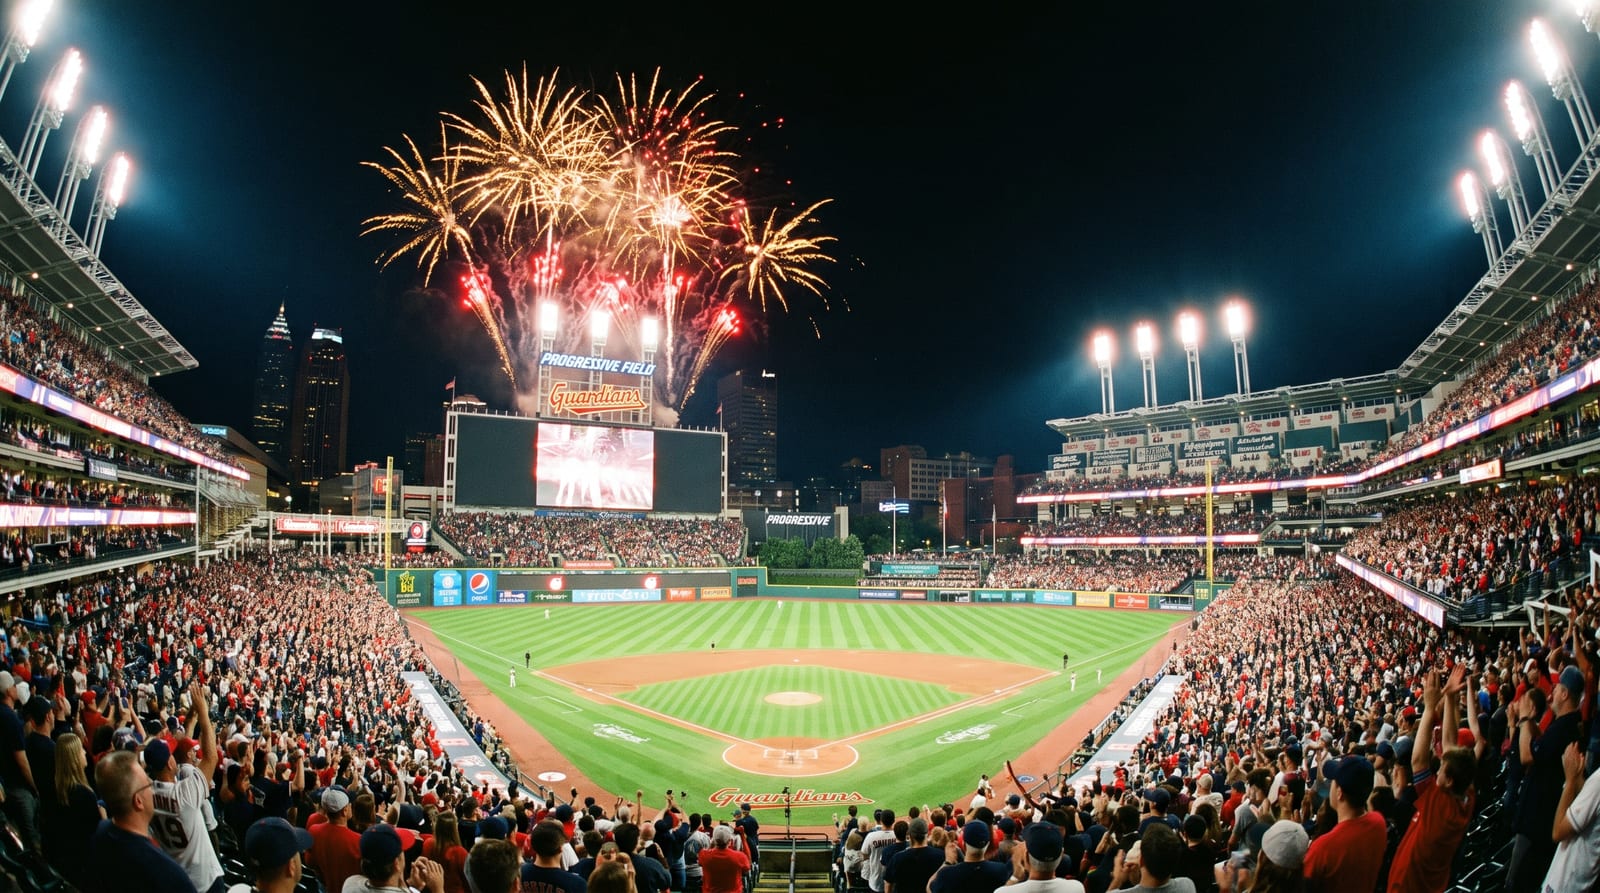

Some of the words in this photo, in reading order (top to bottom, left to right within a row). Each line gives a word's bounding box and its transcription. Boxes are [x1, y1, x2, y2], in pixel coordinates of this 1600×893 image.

[541, 353, 621, 371] PROGRESSIVE
[621, 361, 656, 375] FIELD
[550, 382, 647, 415] Guardians
[766, 514, 831, 525] PROGRESSIVE
[709, 788, 875, 809] Guardians
